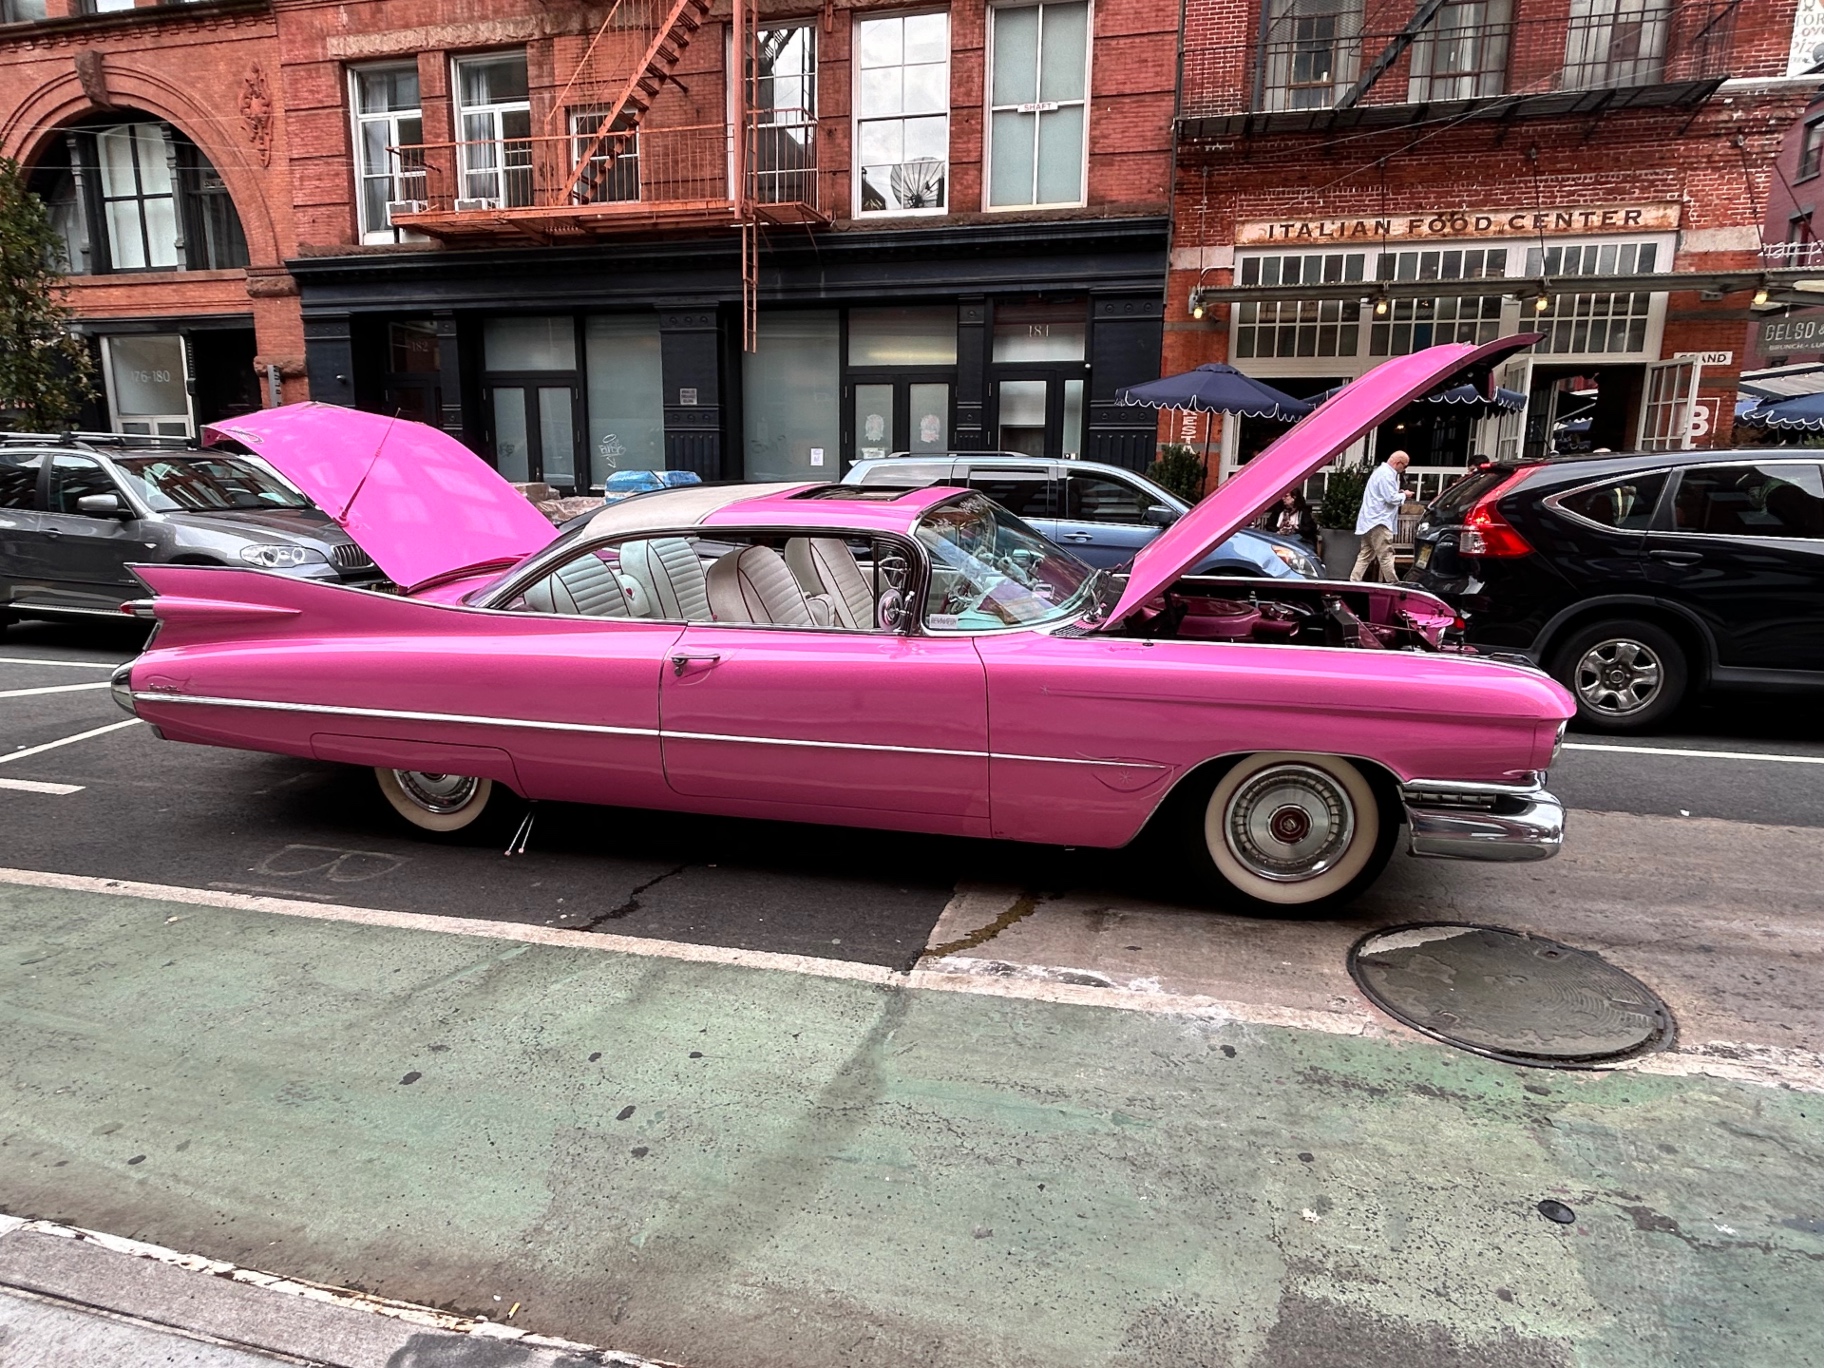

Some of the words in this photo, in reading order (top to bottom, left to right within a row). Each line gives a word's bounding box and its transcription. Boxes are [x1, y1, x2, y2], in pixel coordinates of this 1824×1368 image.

[1024, 102, 1052, 111] SHAFT
[1267, 219, 1392, 239] ITALIAN
[1408, 216, 1493, 234] FOOD
[1508, 209, 1643, 229] CENTER
[1029, 324, 1049, 337] 181
[1765, 321, 1816, 341] GELSO
